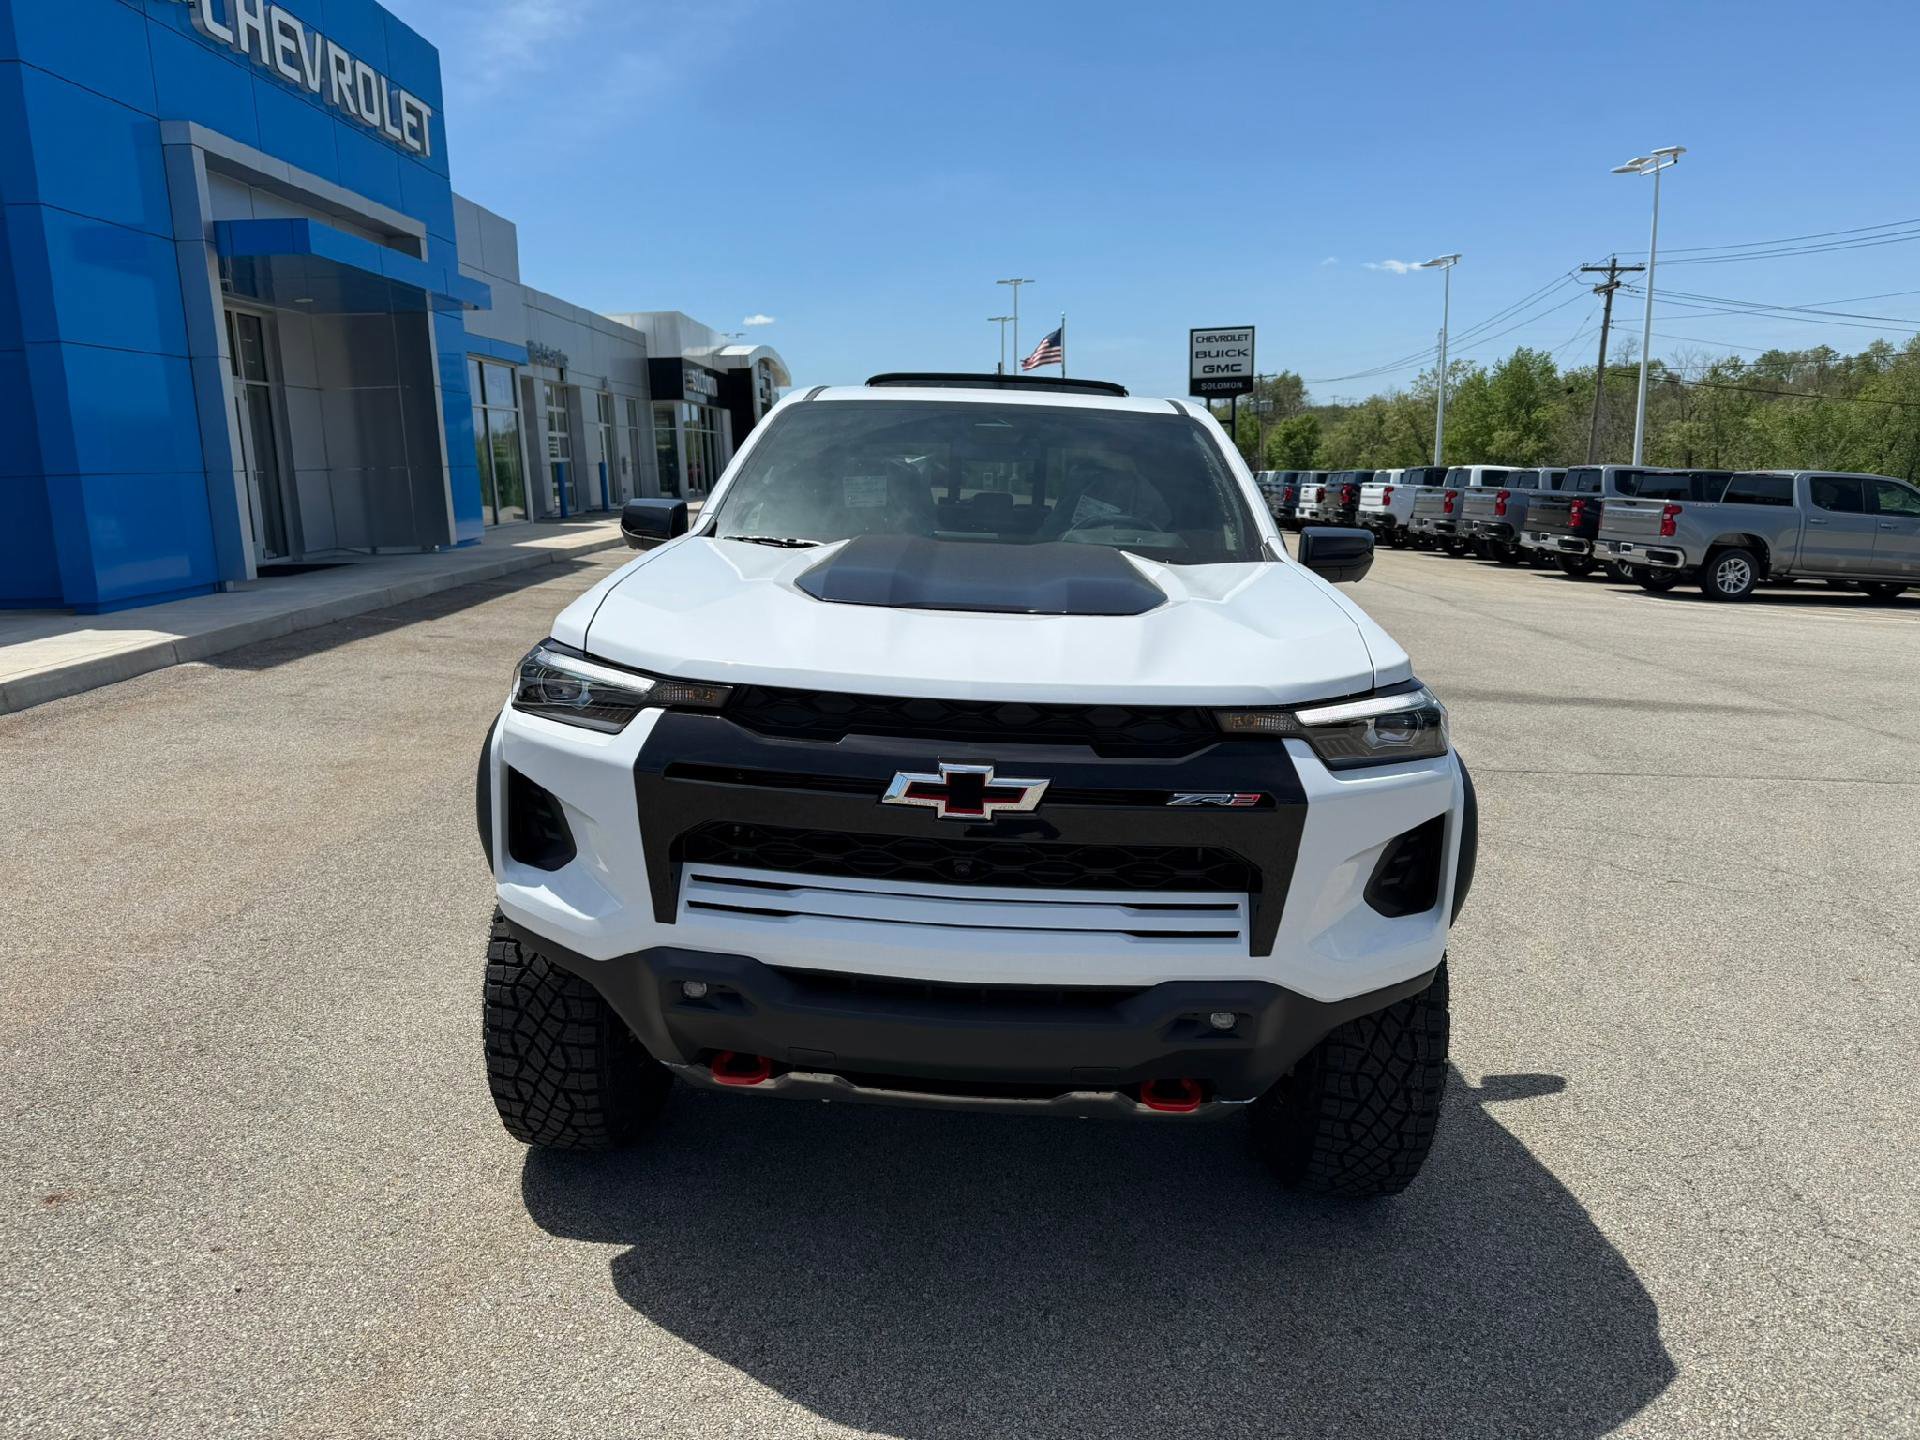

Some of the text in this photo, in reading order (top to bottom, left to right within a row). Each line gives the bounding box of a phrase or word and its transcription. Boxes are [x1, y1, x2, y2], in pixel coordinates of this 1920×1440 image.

[1195, 334, 1249, 344] CHEVROLET
[1195, 349, 1249, 359] BUICK
[1202, 363, 1242, 374] GMC
[1201, 381, 1242, 390] SOLOMON
